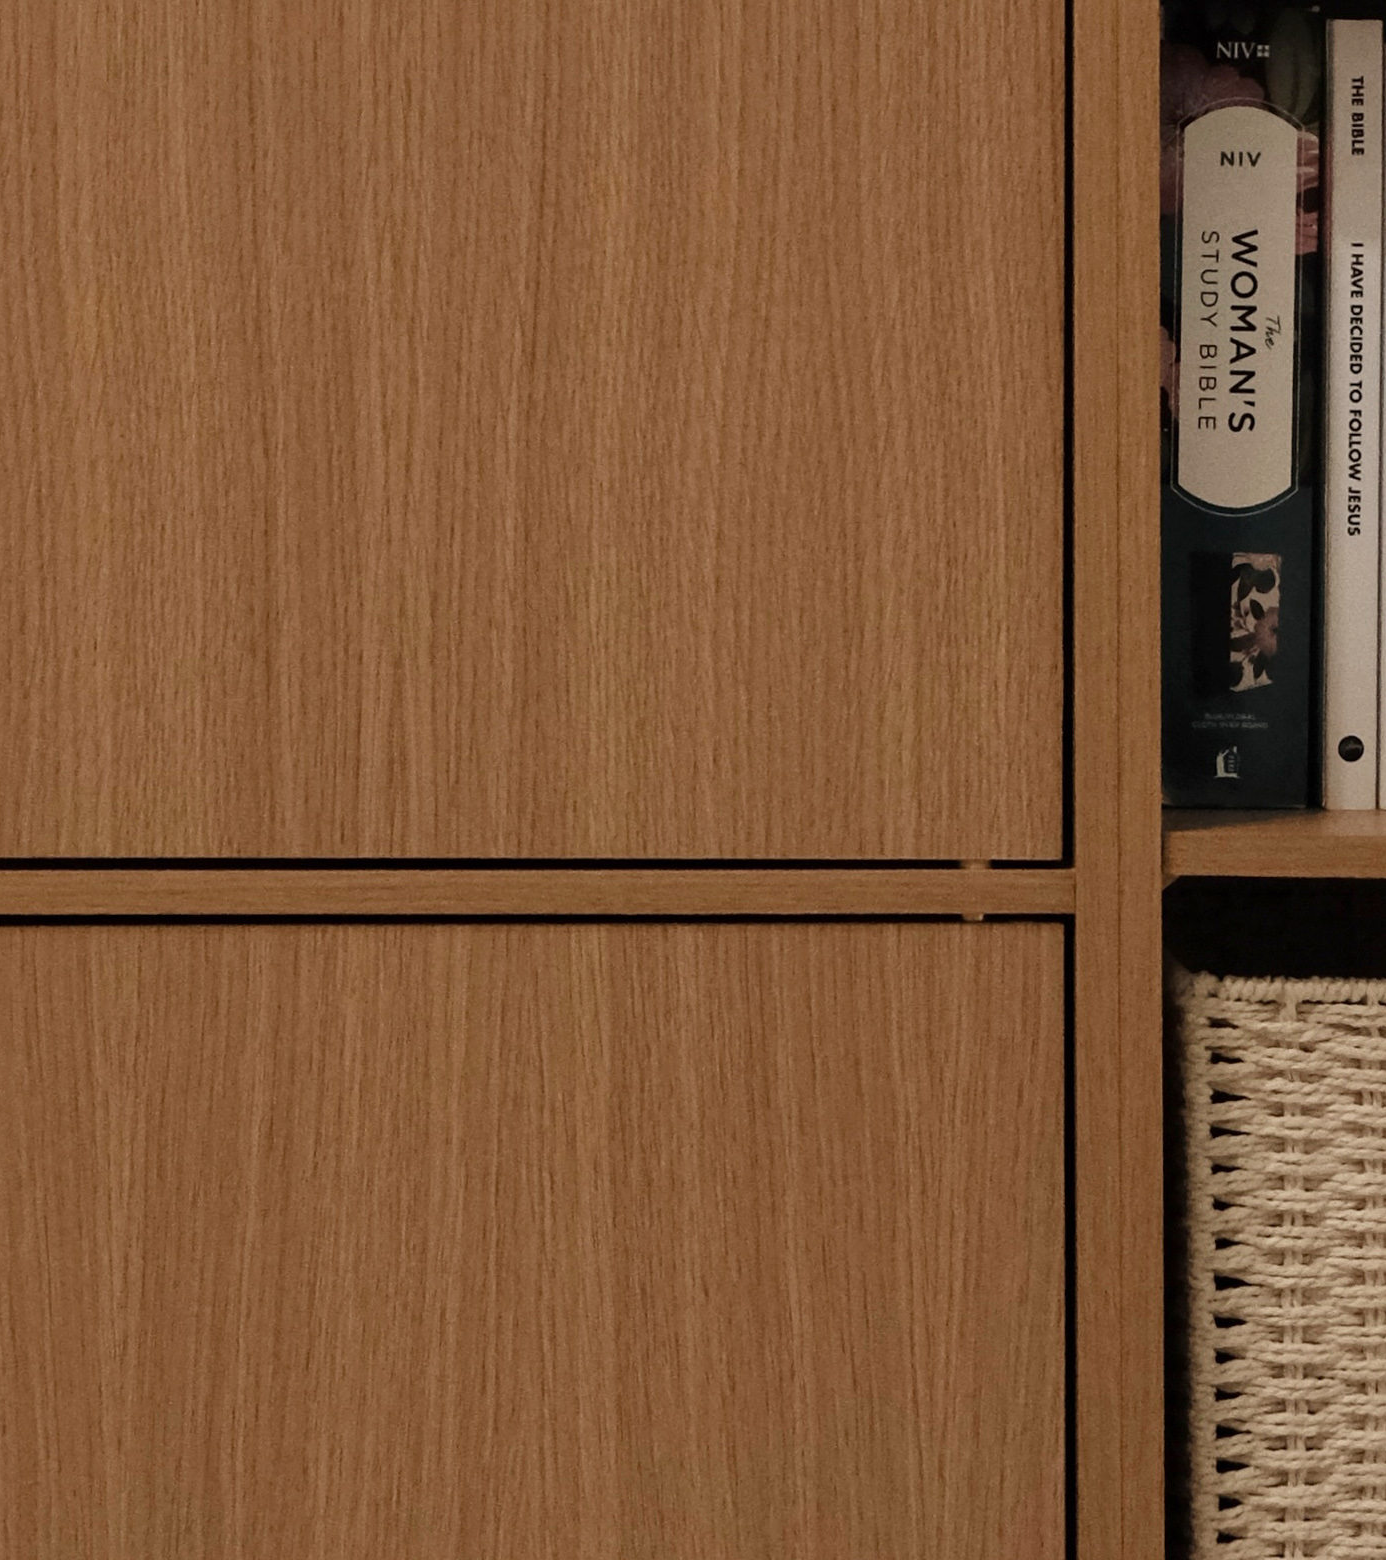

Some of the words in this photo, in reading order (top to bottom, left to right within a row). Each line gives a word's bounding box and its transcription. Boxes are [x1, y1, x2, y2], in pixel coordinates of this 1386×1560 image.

[1217, 41, 1257, 59] NIV
[1351, 76, 1364, 106] THE
[1351, 112, 1365, 156] BIBLE
[1220, 151, 1262, 167] NIV
[1199, 231, 1220, 327] STUDY
[1350, 254, 1363, 298] HAVE
[1228, 230, 1259, 432] WOMAN'S
[1350, 305, 1363, 375] DECIDED
[1198, 345, 1218, 430] BIBLE
[1349, 381, 1363, 403] TO
[1348, 410, 1362, 481] FOLLOW
[1347, 486, 1361, 537] JESUS
